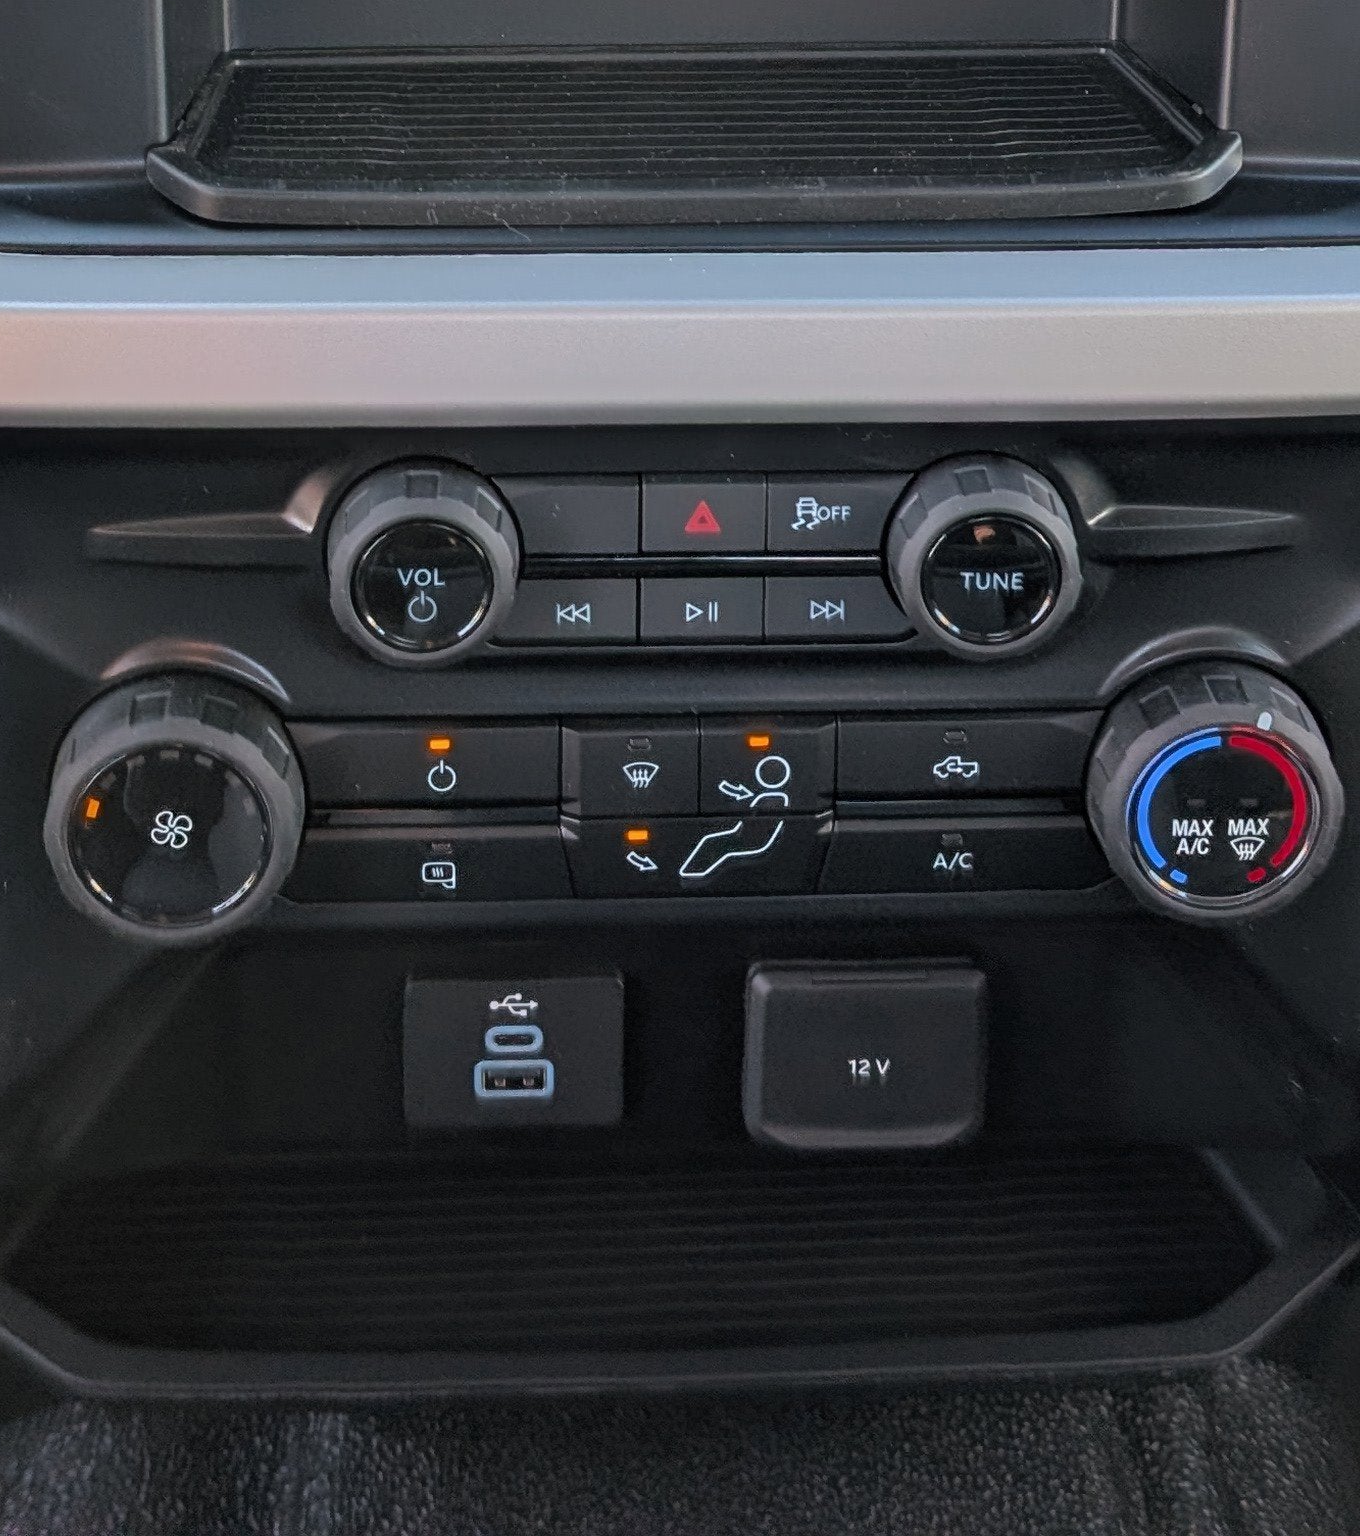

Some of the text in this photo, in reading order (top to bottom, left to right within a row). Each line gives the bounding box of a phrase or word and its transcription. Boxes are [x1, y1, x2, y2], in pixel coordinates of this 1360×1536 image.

[817, 505, 852, 522] OFF
[397, 567, 446, 589] VOL
[960, 570, 1025, 592] TUNE
[1171, 817, 1215, 837] MAX
[1226, 817, 1270, 837] MAX
[1175, 836, 1211, 856] A/C
[932, 851, 974, 870] A/C
[847, 1058, 891, 1077] 12 V
